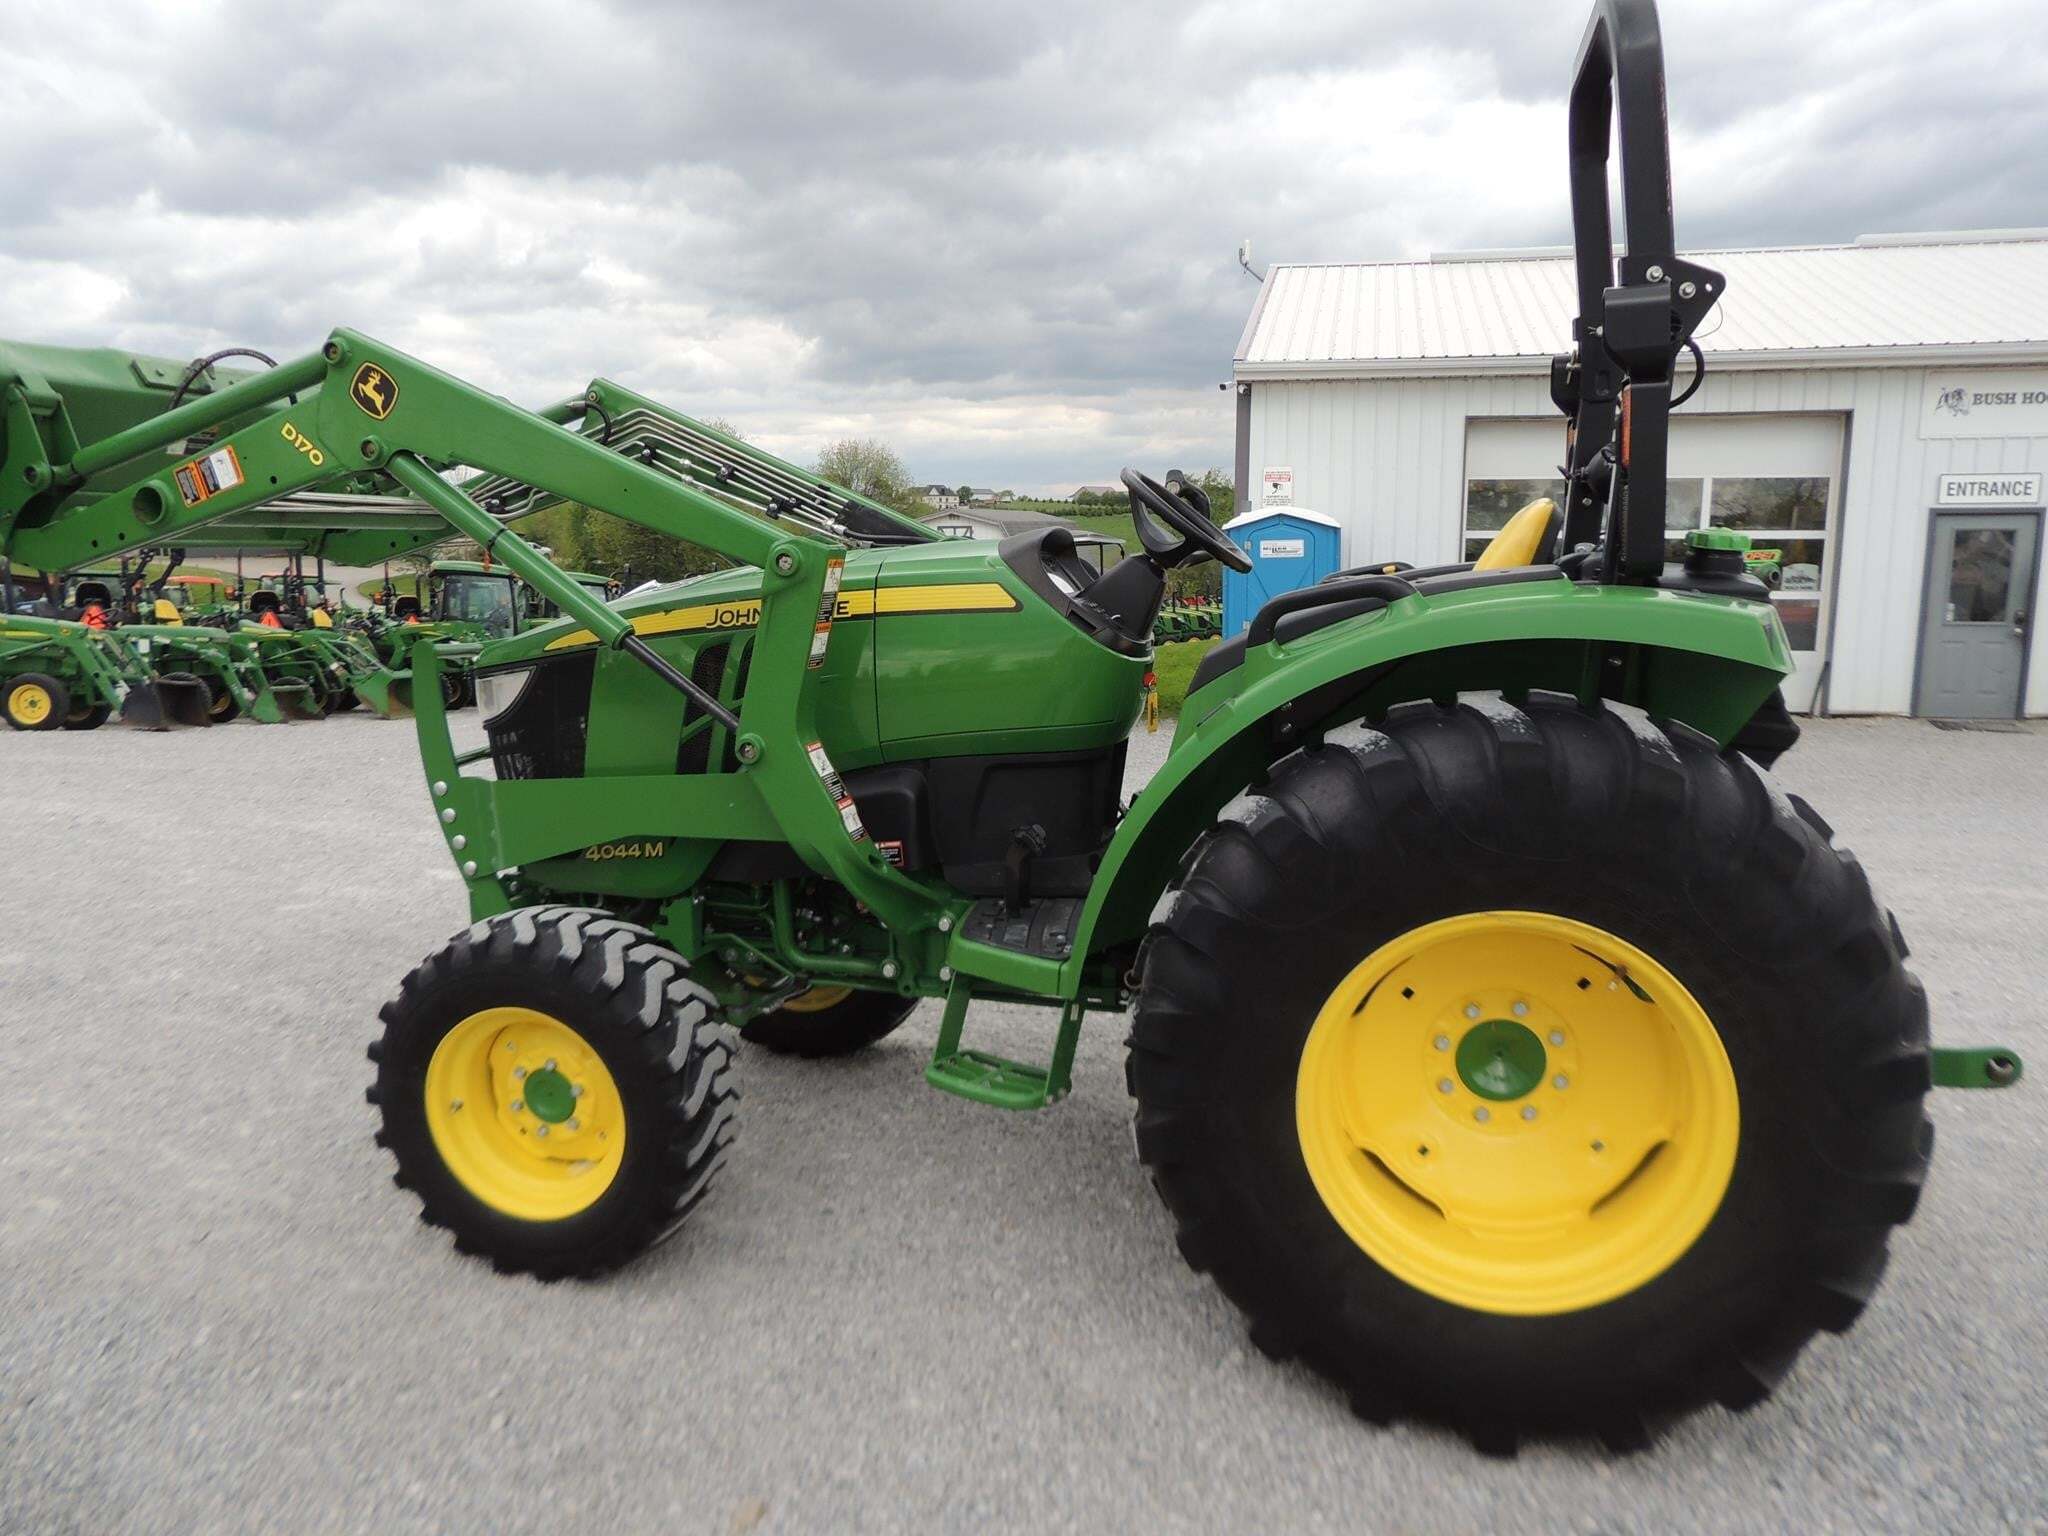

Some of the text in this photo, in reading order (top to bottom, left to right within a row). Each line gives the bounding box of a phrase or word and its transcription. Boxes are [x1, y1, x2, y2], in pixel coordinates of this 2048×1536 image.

[1972, 390, 2048, 405] BUSH HO
[281, 421, 324, 466] D170
[1946, 481, 2033, 496] ENTRANCE
